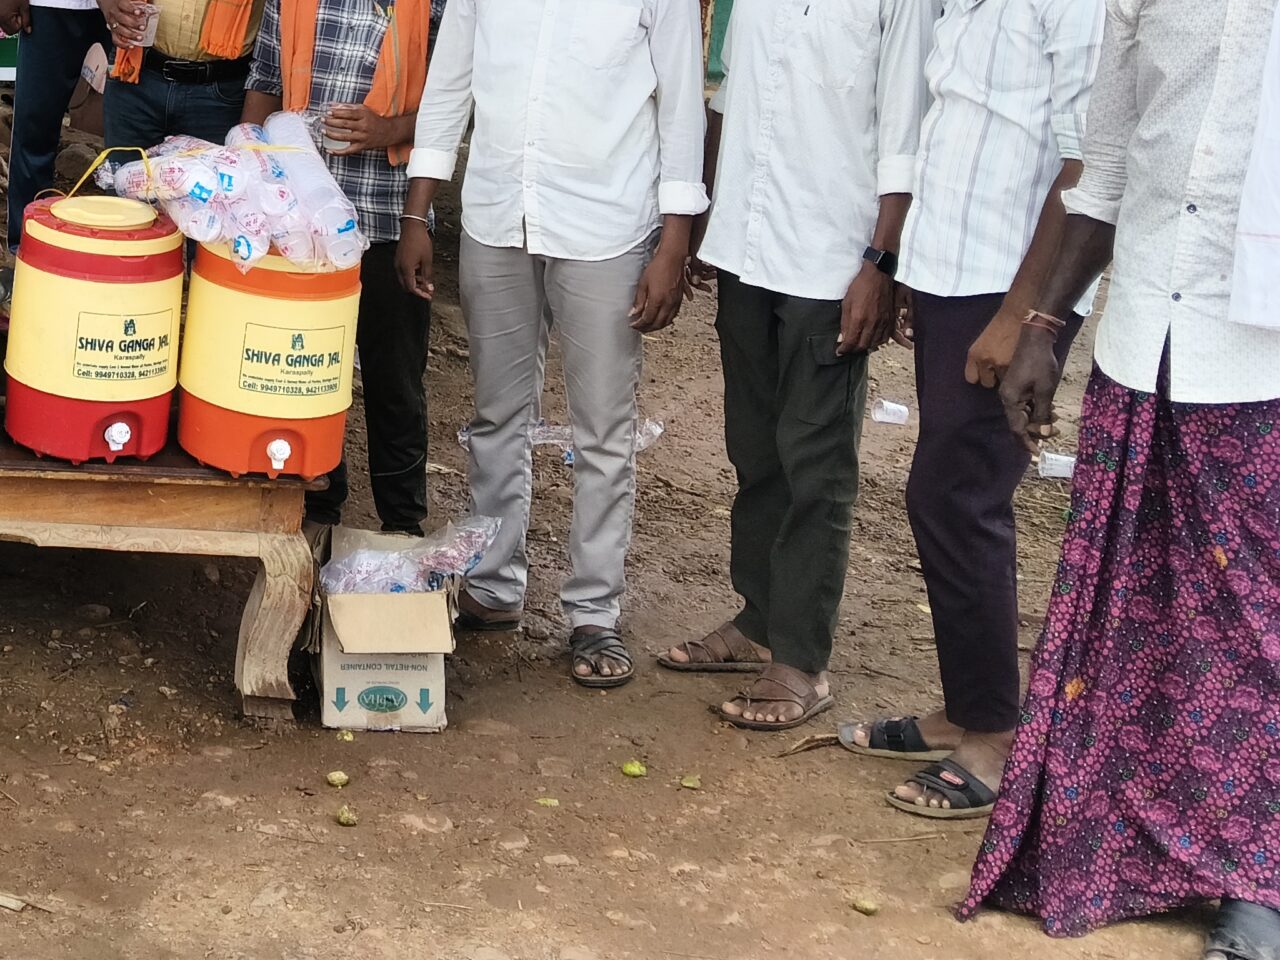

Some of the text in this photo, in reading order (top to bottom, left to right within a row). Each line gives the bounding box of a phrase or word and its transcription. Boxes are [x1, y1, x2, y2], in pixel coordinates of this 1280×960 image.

[78, 337, 114, 353] SHIVA
[119, 337, 155, 353] GANGA
[244, 348, 340, 368] SHIVA GANGA JAL
[242, 381, 258, 389] Cell:
[341, 663, 382, 671] CONTAINER
